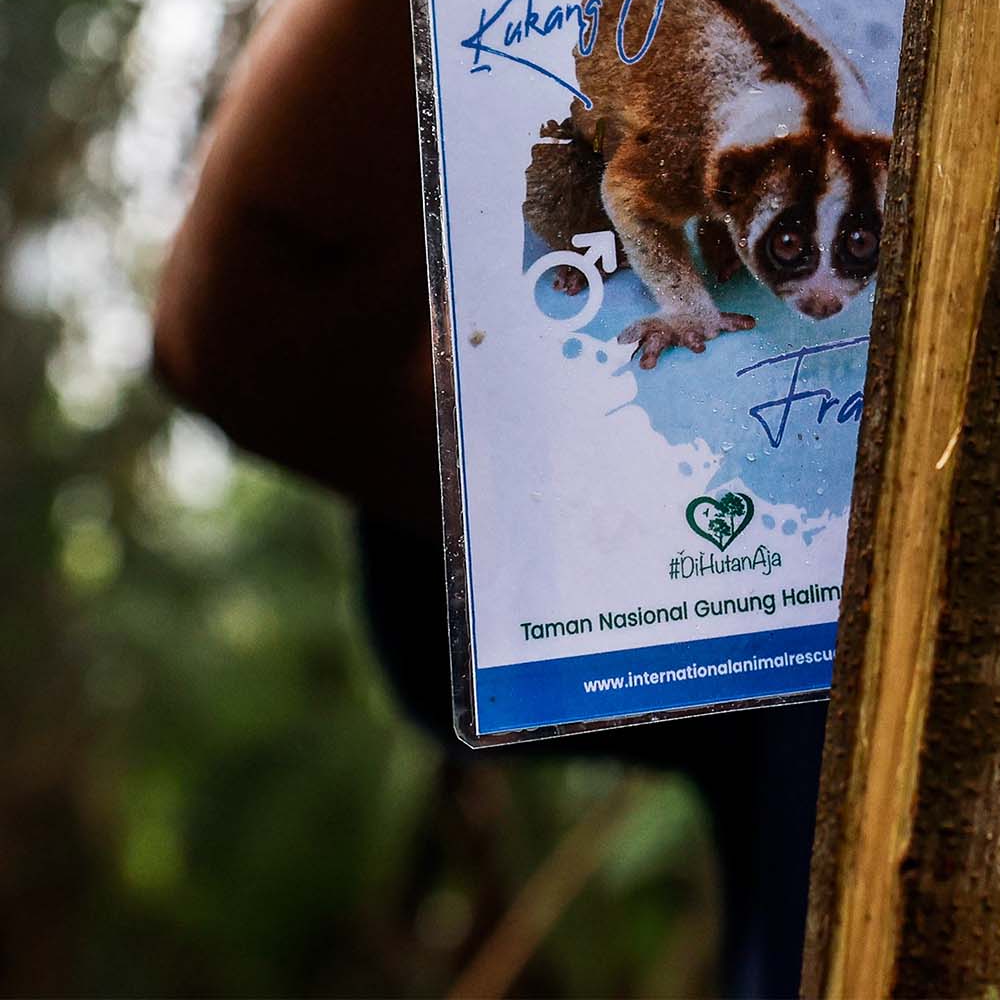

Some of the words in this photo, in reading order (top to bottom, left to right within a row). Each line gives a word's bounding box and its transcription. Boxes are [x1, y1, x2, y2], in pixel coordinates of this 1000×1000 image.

[669, 544, 782, 580] #DiHutanAja
[520, 615, 593, 641] Taman
[599, 602, 688, 631] Nasional
[694, 591, 776, 618] Gunung
[782, 583, 843, 607] Halim
[583, 648, 836, 694] www.internationalanimalrescu
